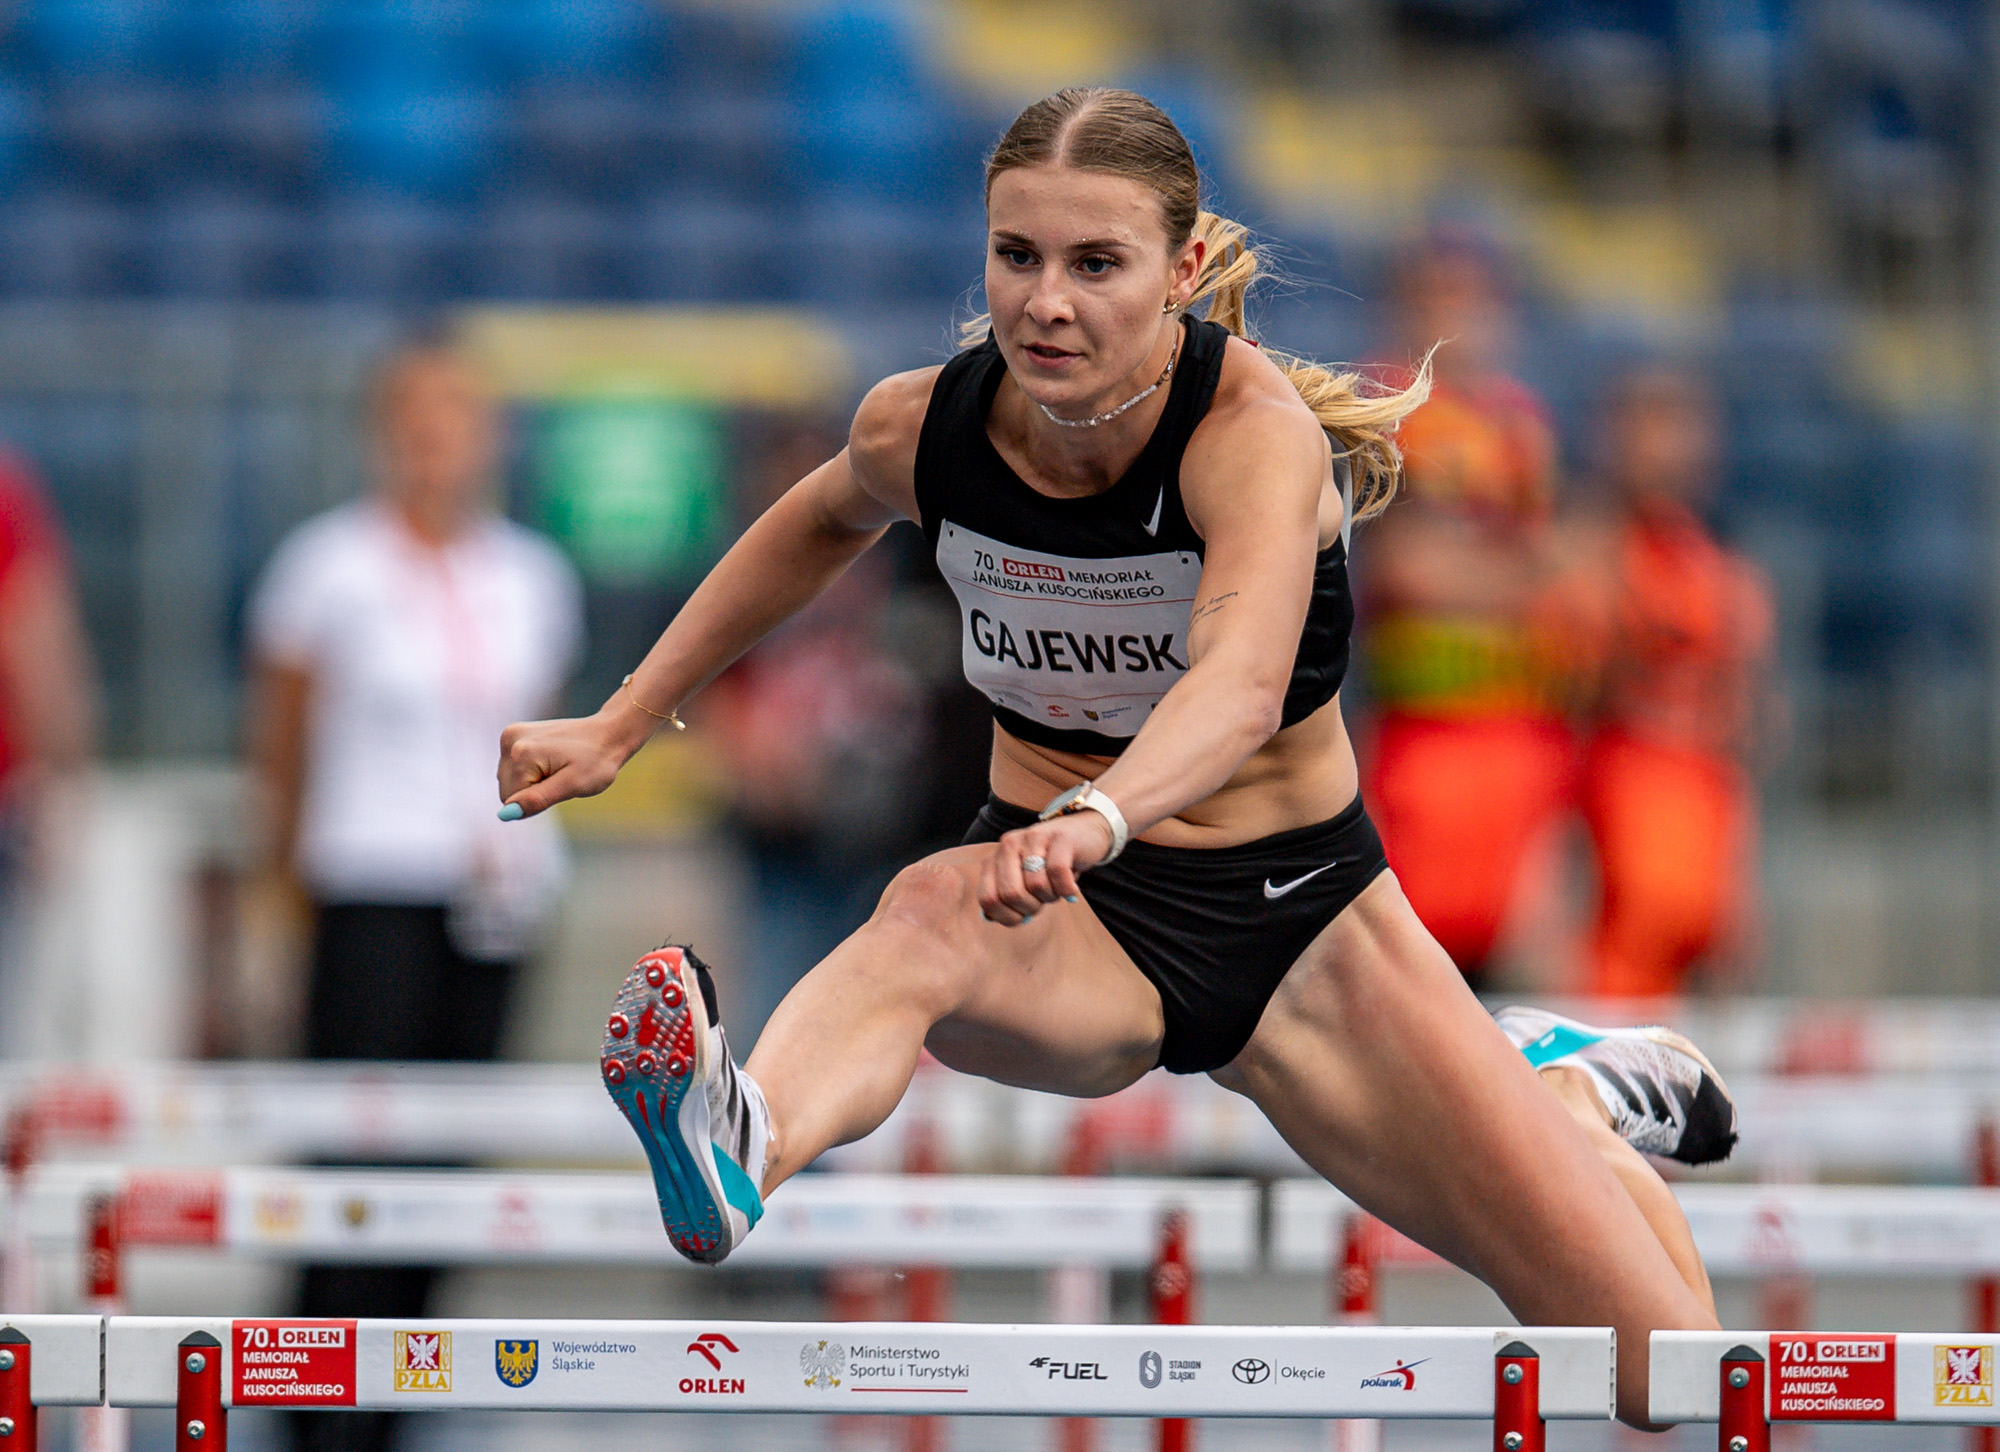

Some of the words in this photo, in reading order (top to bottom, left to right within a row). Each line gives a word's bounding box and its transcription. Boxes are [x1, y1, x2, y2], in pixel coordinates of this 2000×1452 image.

[973, 550, 1000, 572] 70.
[1005, 560, 1062, 580] ORLEN
[1068, 569, 1154, 585] MEMORIAŁ
[972, 570, 1034, 593] JANUSZA
[1038, 575, 1165, 600] KUSOCIŃSKIEGO
[970, 608, 1190, 673] GAJEWSK
[241, 1327, 275, 1349] 70.
[282, 1331, 341, 1344] ORLEN
[552, 1341, 637, 1354] Województwo
[850, 1345, 940, 1360] Ministerstwo
[1779, 1341, 1814, 1363] 70.
[1821, 1344, 1880, 1359] ORLEN
[243, 1351, 310, 1364] MEMORIAŁ
[1169, 1360, 1202, 1370] STADION
[552, 1359, 595, 1372] Śląskie
[850, 1364, 896, 1379] Sportu
[899, 1364, 903, 1377] i
[909, 1364, 970, 1379] Turystyki
[1048, 1363, 1109, 1380] FUEL
[1281, 1366, 1326, 1380] Okęcie
[1780, 1365, 1849, 1379] MEMORIAŁ
[243, 1368, 298, 1380] JANUSZA
[397, 1372, 448, 1389] PZLA
[1169, 1370, 1196, 1382] ŚLĄSKI
[243, 1384, 345, 1396] KUSOCIŃSKIEGO
[678, 1378, 745, 1394] ORLEN
[1360, 1377, 1403, 1390] polanik
[1780, 1382, 1838, 1395] JANUSZA
[1780, 1396, 1885, 1411] KUSOCIŃSKIEGO
[1936, 1387, 1990, 1405] PZLA
